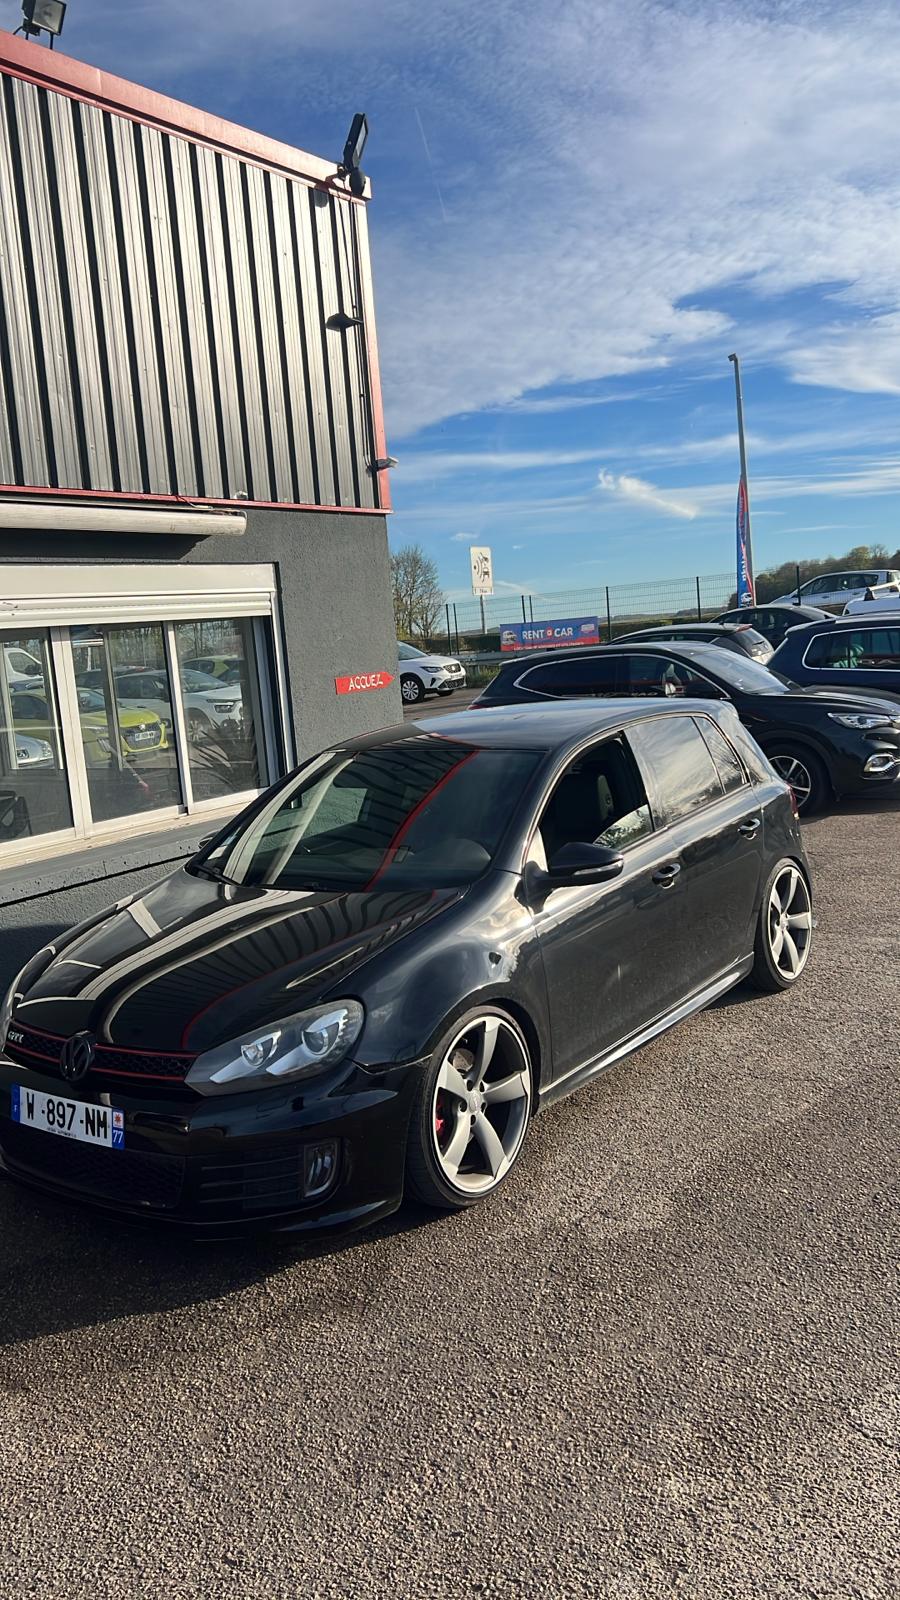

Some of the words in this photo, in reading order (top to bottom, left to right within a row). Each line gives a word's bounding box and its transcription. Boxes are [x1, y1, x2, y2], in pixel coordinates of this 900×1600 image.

[522, 630, 545, 640] RENT
[554, 627, 574, 638] CAR
[112, 1129, 124, 1144] 77
